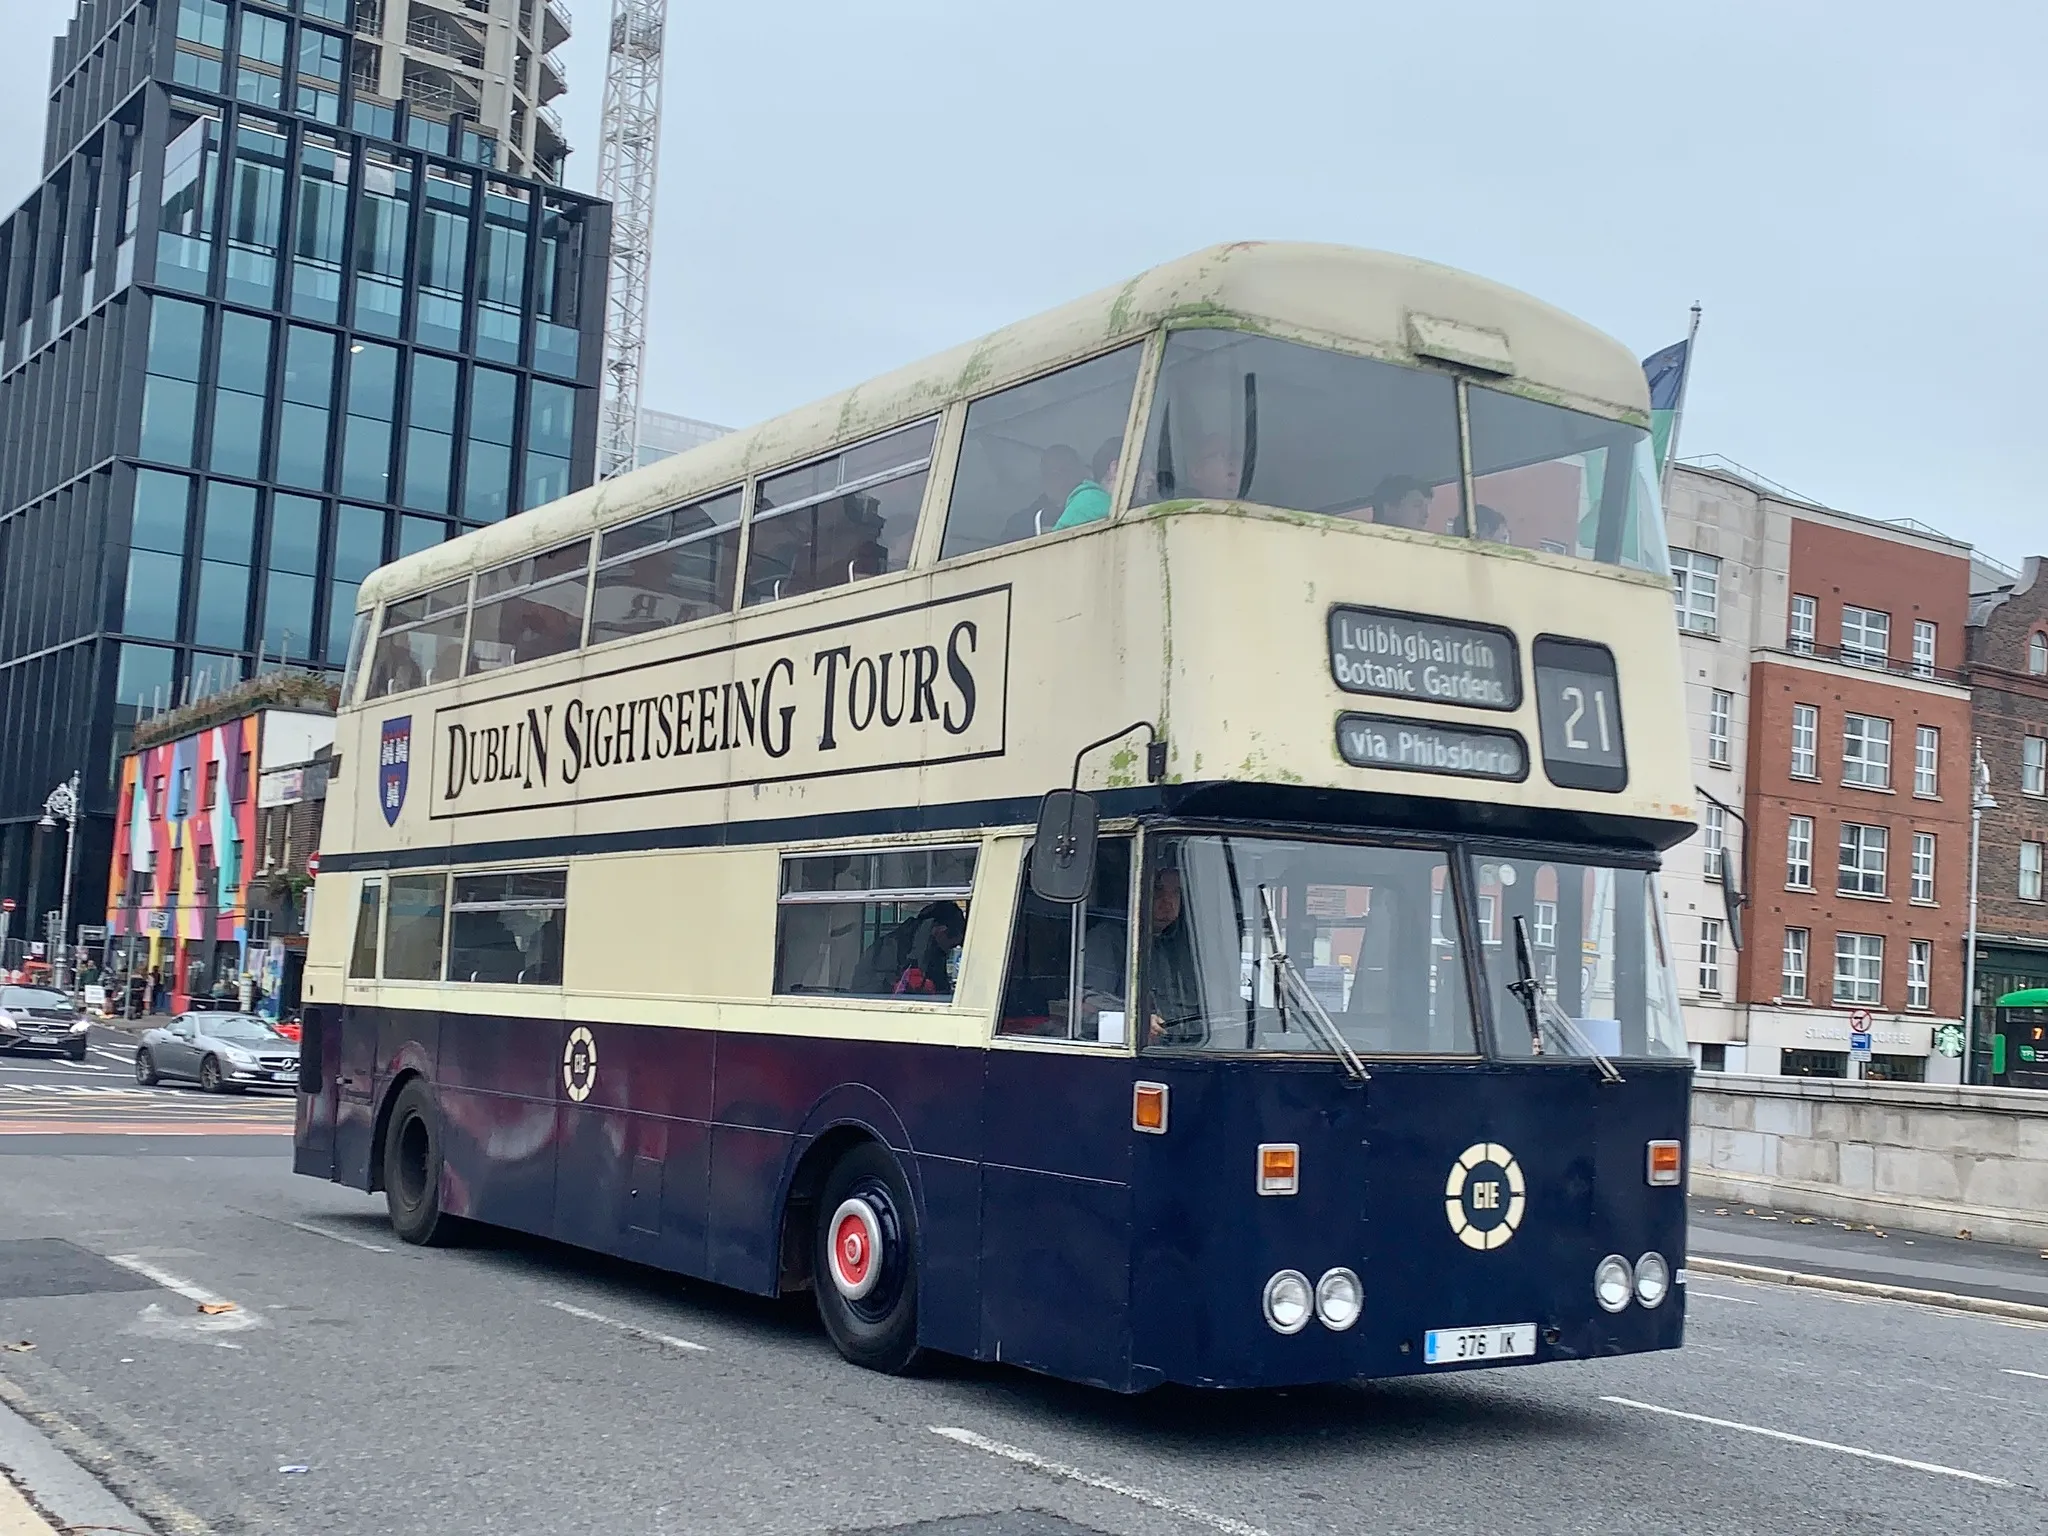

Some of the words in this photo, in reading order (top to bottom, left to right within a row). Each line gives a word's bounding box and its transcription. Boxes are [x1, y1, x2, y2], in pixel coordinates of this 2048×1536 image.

[1334, 652, 1416, 693] Botanic
[1423, 666, 1504, 704] Gardens
[1561, 686, 1611, 752] 21
[1350, 728, 1389, 769] via
[1398, 731, 1515, 776] Phibsboro
[2033, 1027, 2043, 1040] 7
[1473, 1181, 1500, 1210] CIE
[1456, 1334, 1488, 1358] 376
